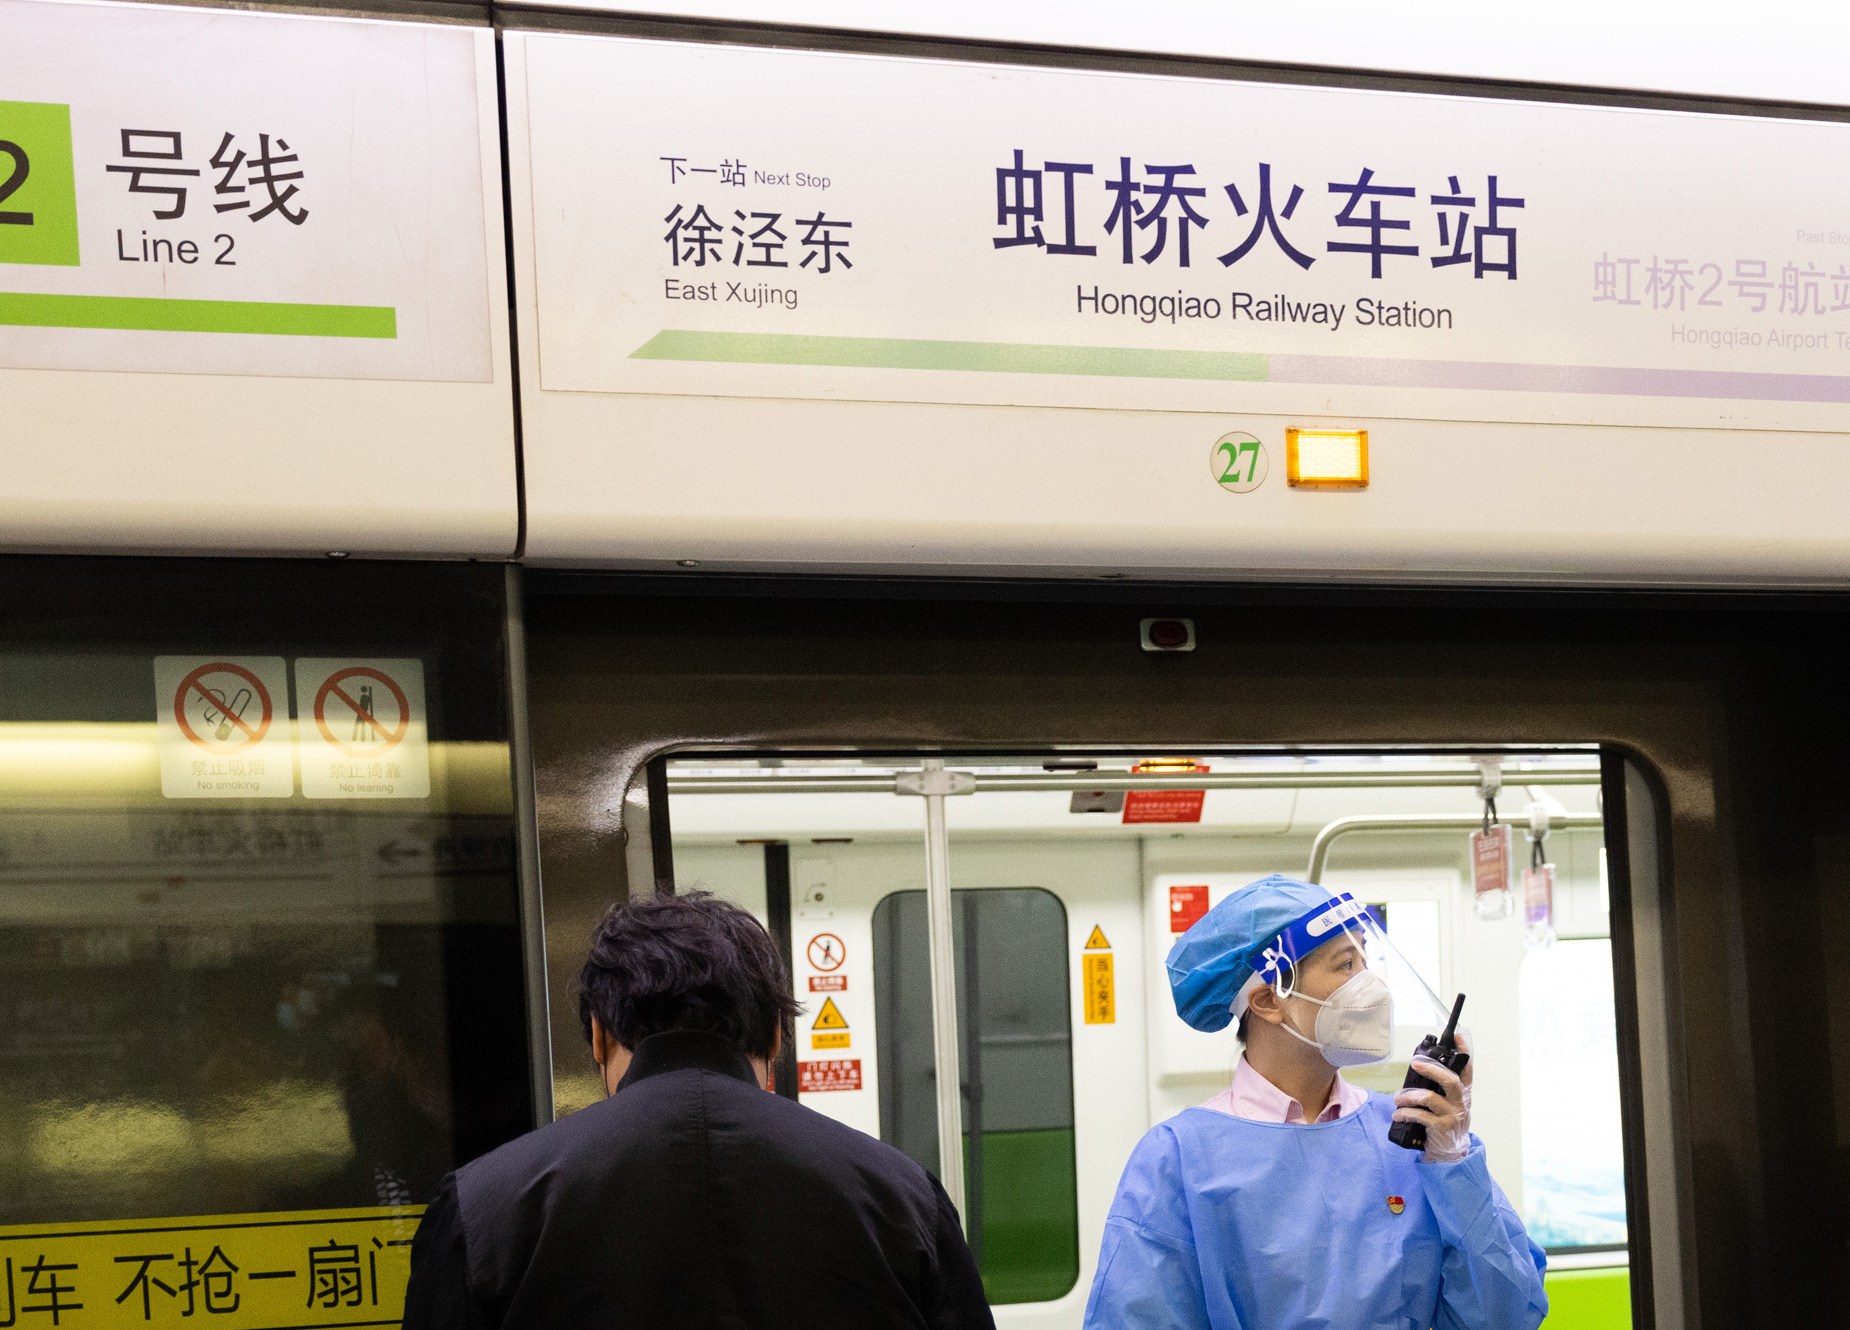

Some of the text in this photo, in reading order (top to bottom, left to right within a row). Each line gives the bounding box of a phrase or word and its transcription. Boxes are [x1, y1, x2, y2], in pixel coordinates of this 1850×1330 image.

[105, 128, 310, 227] 号线
[659, 156, 747, 188] 下一站
[754, 170, 832, 190] Next Stop
[992, 149, 1525, 280] 虹桥火车站
[117, 228, 237, 266] Line 2
[663, 203, 855, 275] 徐泾东
[1796, 229, 1824, 244] Past
[664, 279, 800, 310] East Xujing
[1076, 285, 1453, 332] Hongqiao Railway Station
[1672, 324, 1762, 349] Hongqiao
[1767, 328, 1829, 352] Airport
[1216, 442, 1261, 484] 27
[190, 759, 266, 777] 禁止吸烟
[330, 762, 402, 780] 禁止倚靠
[197, 780, 259, 792] No smoking
[339, 782, 394, 794] No leaning
[0, 1254, 84, 1328] 车
